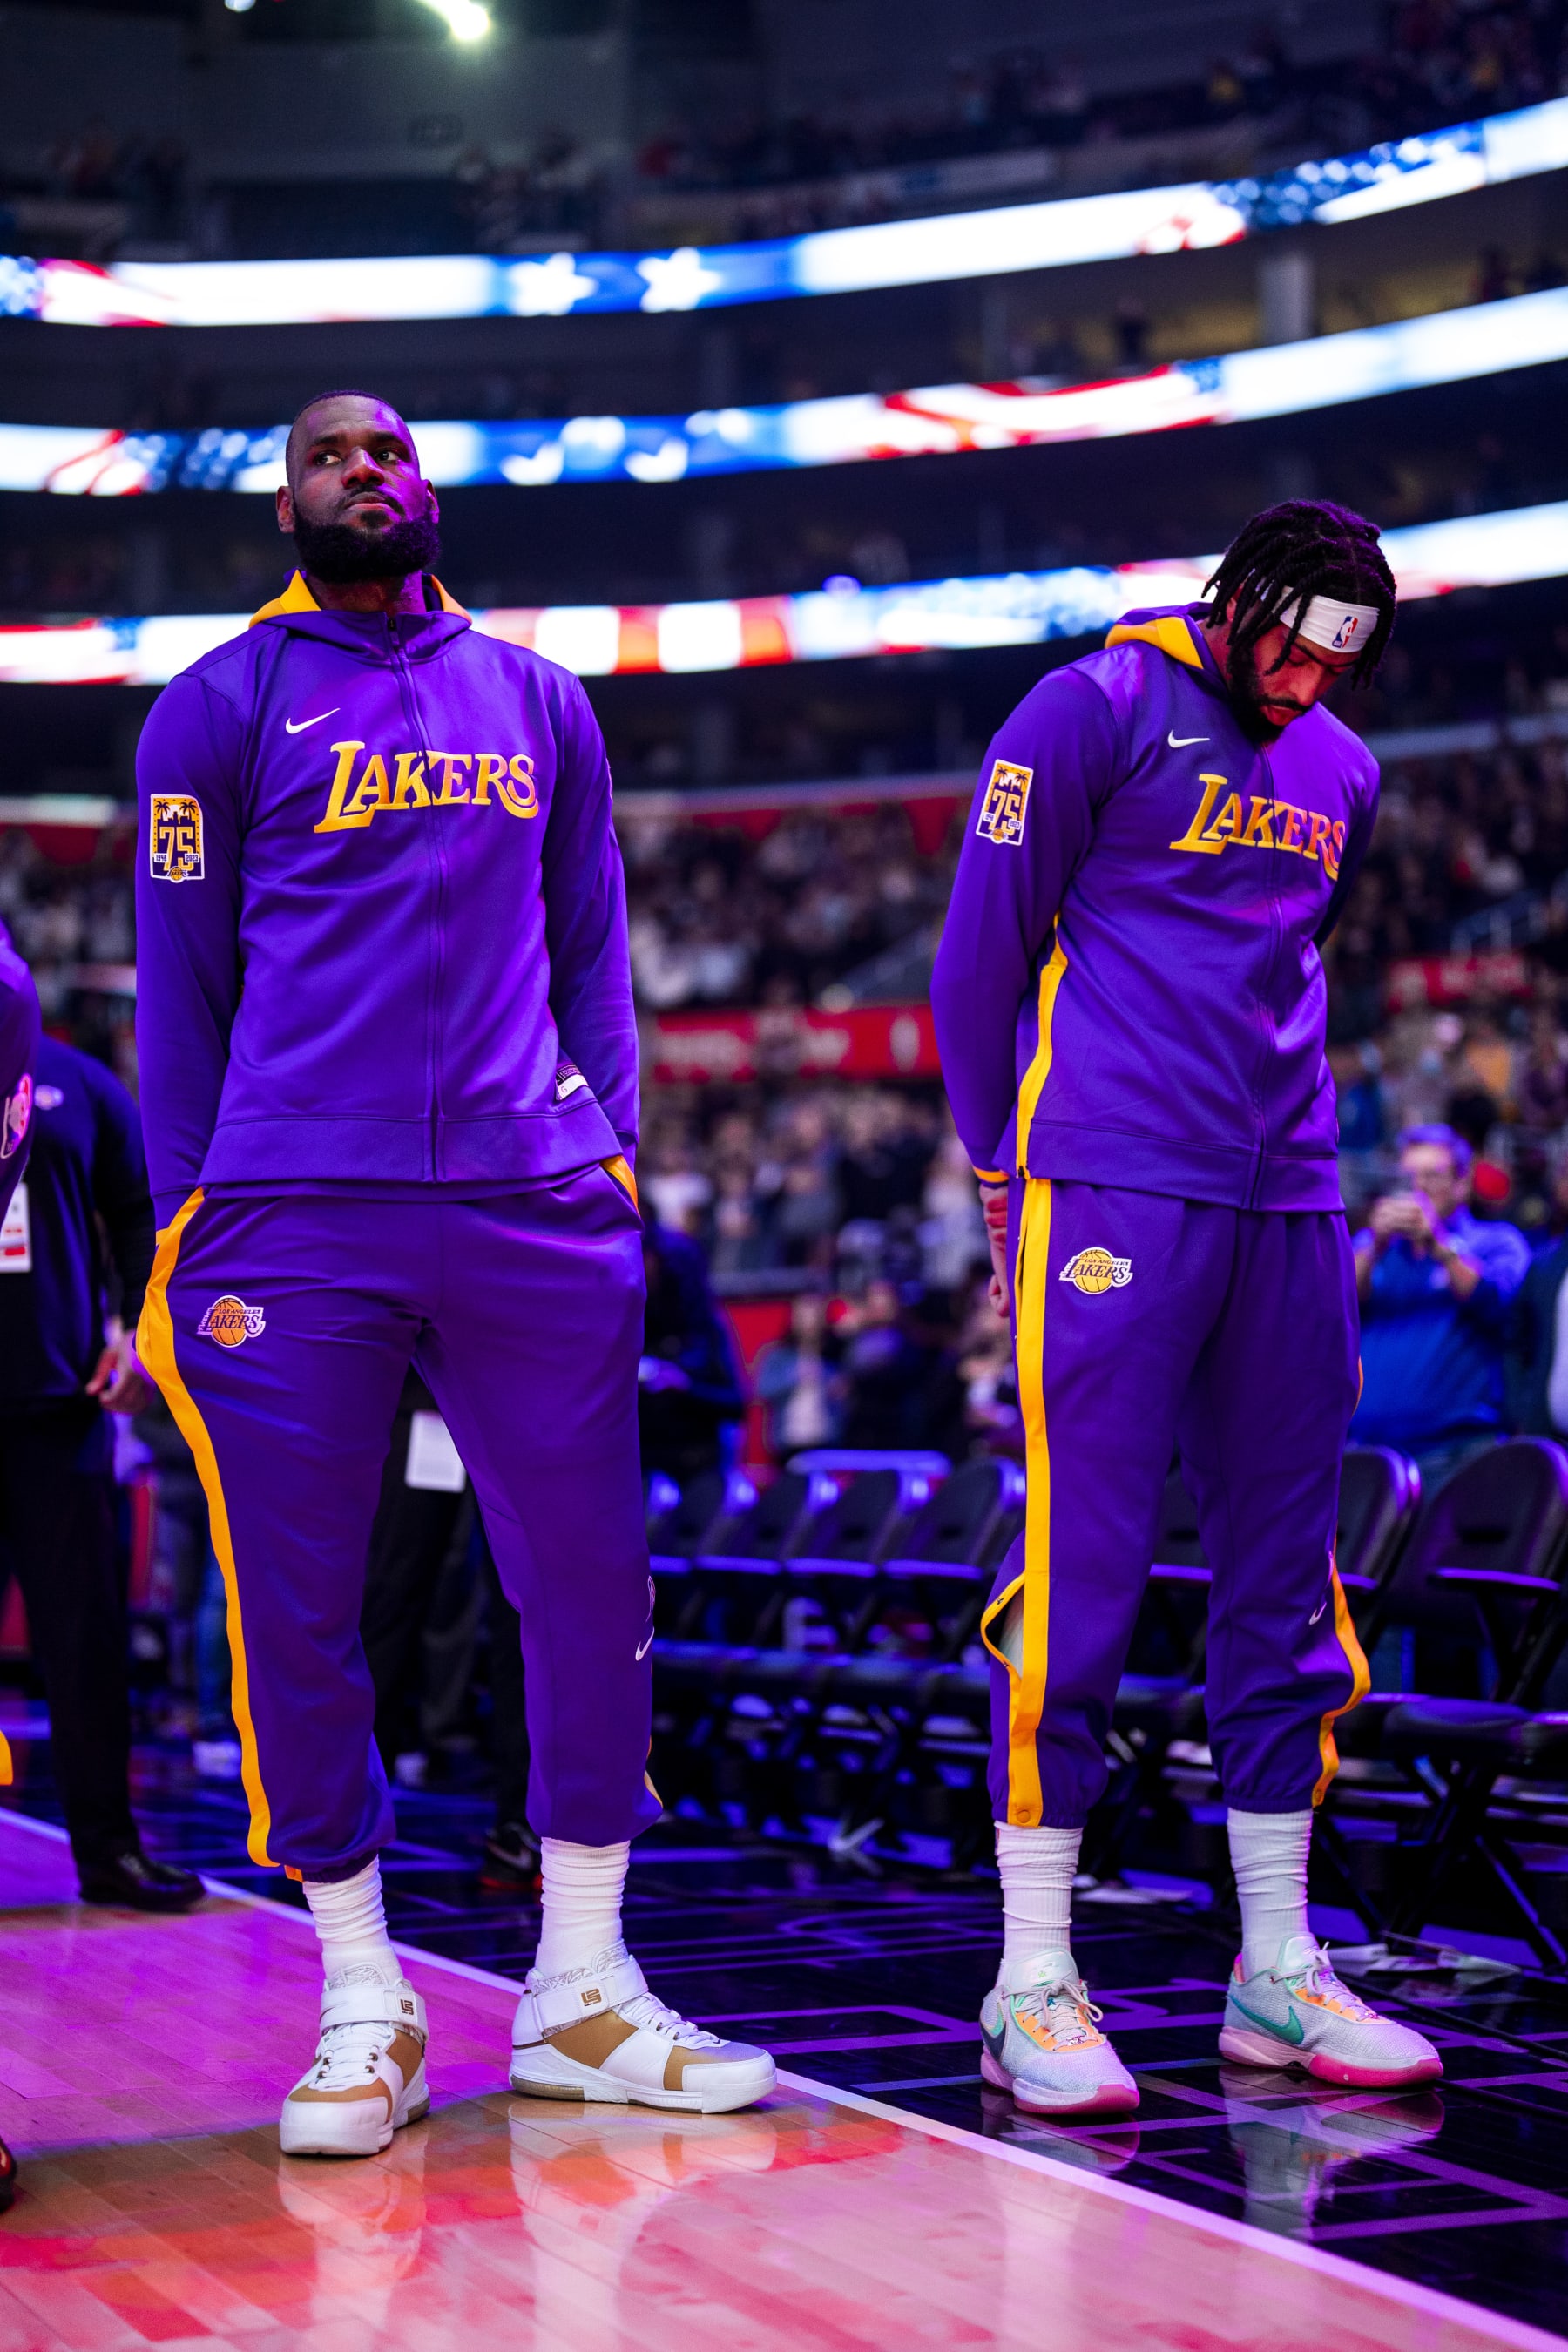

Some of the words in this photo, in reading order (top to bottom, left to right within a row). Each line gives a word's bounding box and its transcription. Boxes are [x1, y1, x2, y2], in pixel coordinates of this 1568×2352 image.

[314, 740, 539, 834] LAKERS
[989, 789, 1020, 835] 75
[1169, 774, 1346, 882] LAKERS
[159, 827, 194, 871] 75
[1064, 1258, 1131, 1284] LAKERS
[201, 1308, 263, 1335] LAKERS
